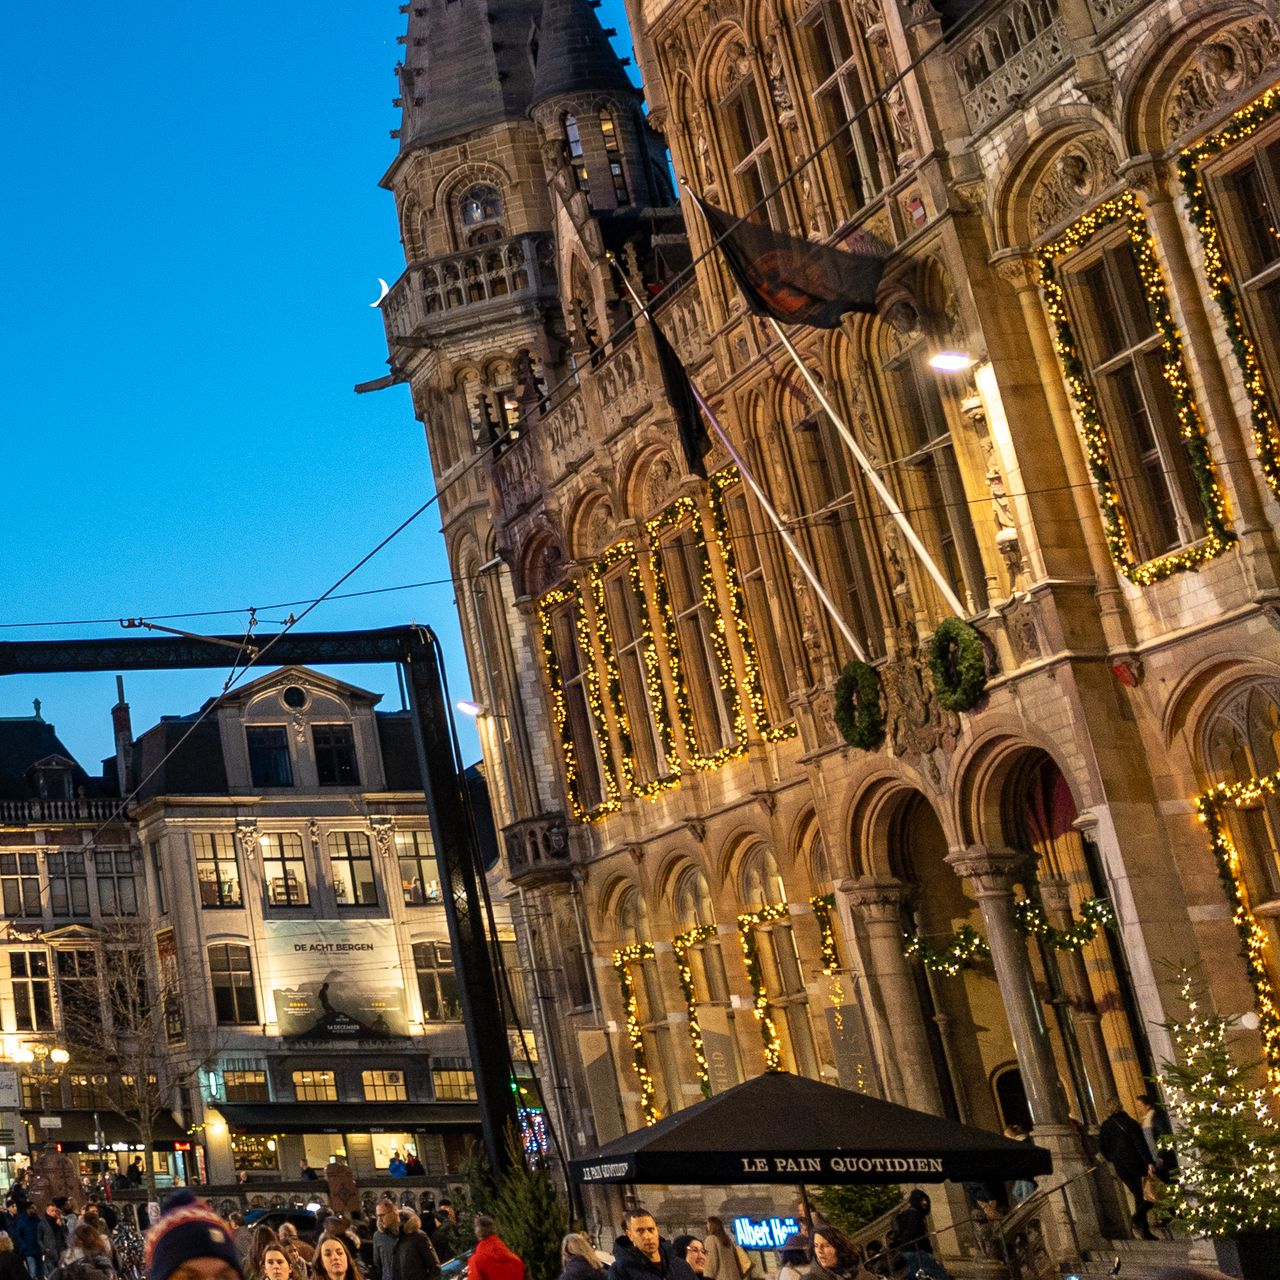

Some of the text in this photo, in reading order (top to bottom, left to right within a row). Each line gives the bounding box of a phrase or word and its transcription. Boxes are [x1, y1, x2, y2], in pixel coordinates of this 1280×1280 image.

[294, 943, 374, 952] DE ACHT BERGEN
[741, 1157, 944, 1173] LE PAIN QUOTIDIEN
[734, 1217, 774, 1247] Albert
